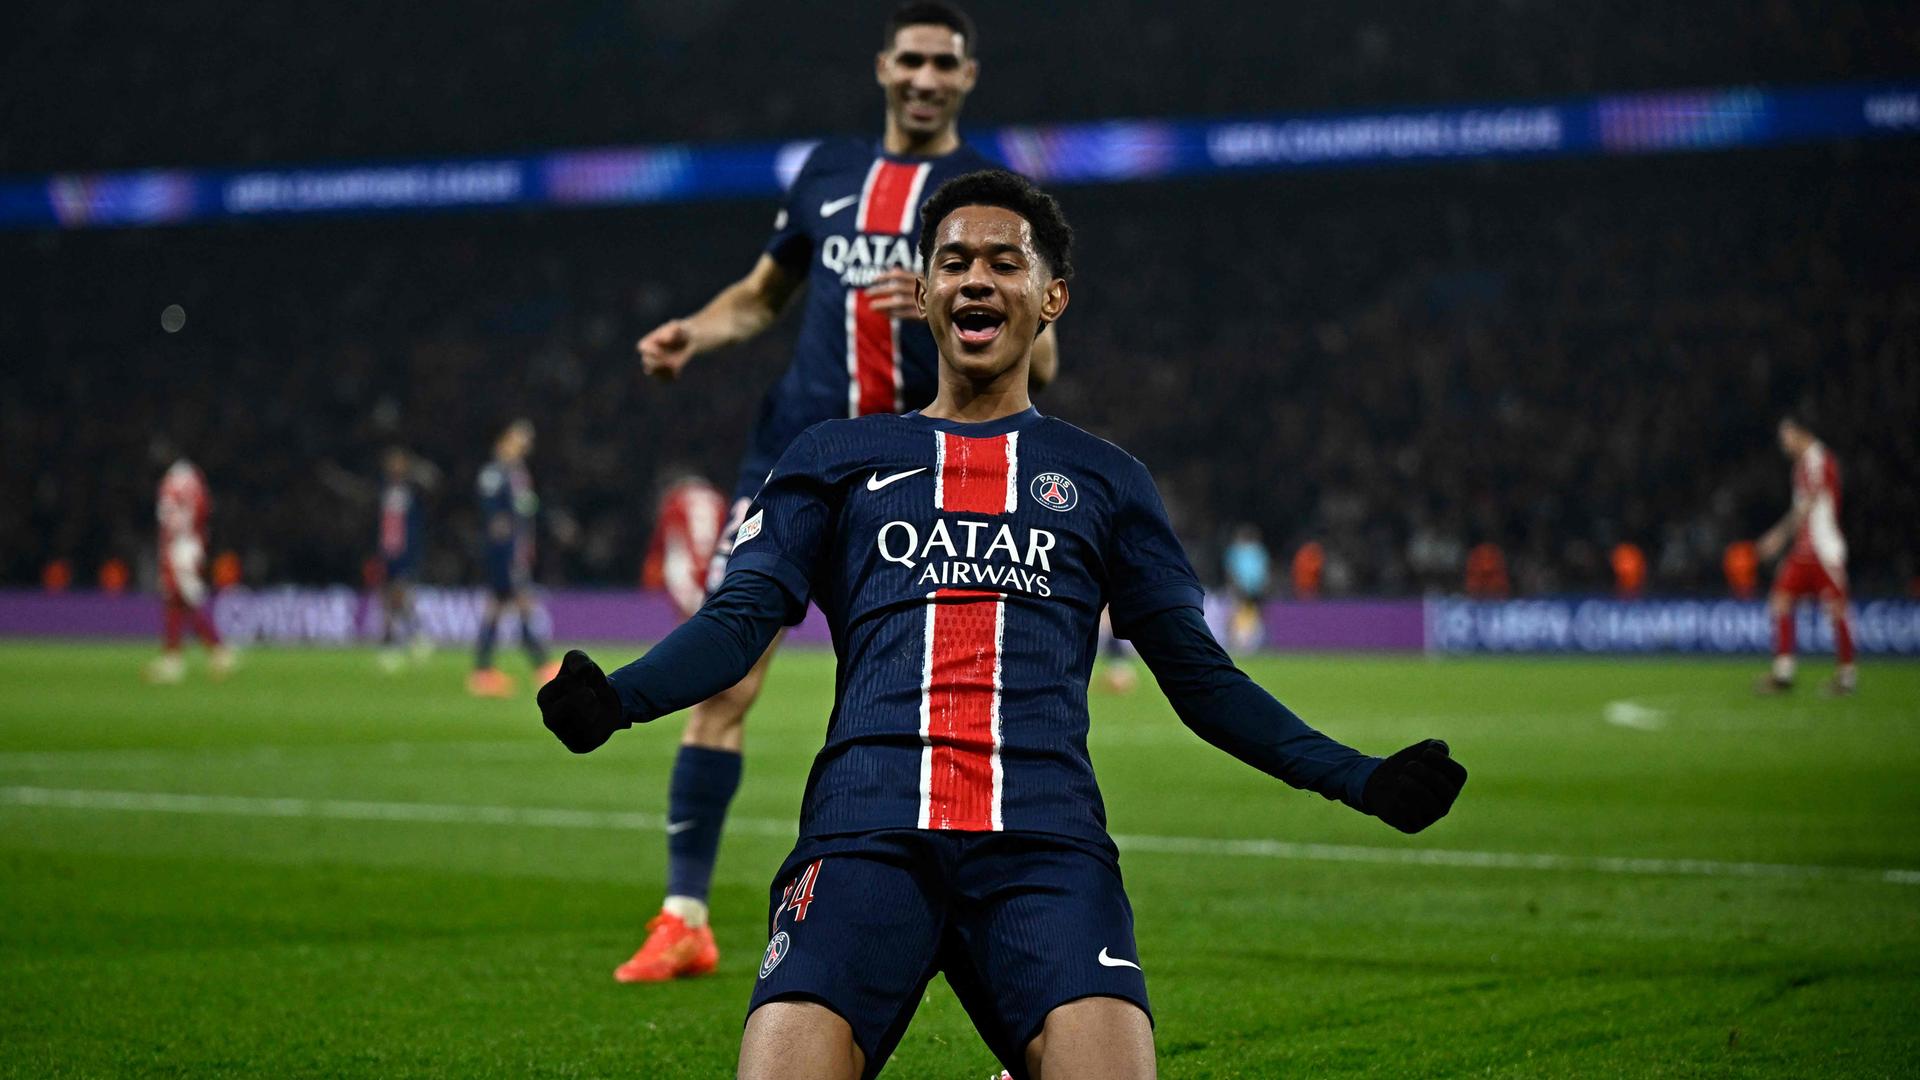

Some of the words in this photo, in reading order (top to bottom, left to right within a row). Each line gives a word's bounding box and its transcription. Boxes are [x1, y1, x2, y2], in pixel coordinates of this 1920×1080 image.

[1039, 475, 1071, 489] PARIS
[877, 519, 1056, 573] QATAR
[918, 561, 1051, 598] AIRWAYS
